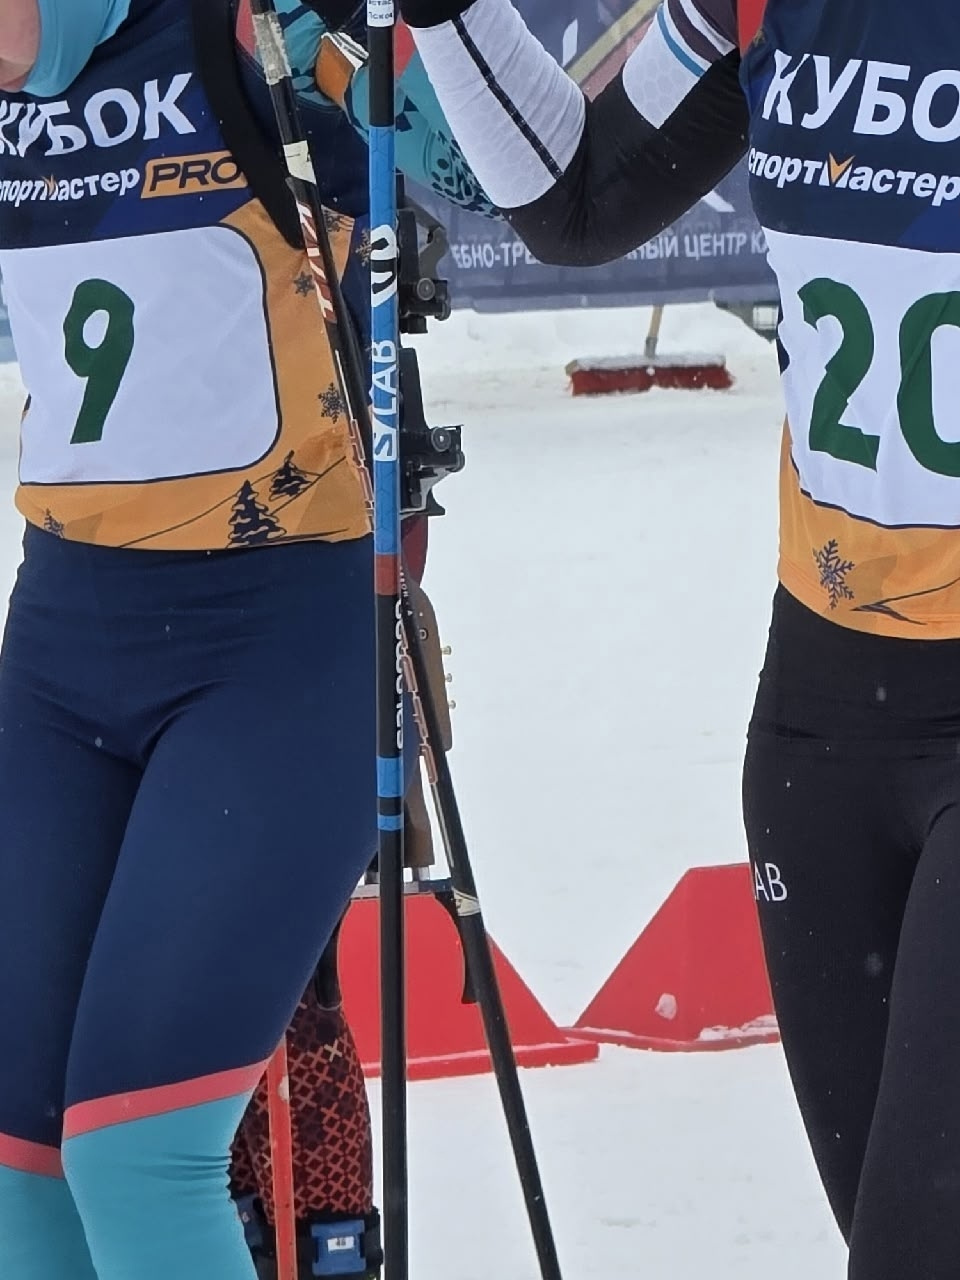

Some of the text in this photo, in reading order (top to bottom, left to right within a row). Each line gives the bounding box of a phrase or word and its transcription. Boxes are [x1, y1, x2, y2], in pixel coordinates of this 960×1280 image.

[0, 72, 197, 158] КУБОК
[149, 156, 242, 192] PRO
[684, 232, 747, 261] ЦЕНТР
[62, 278, 136, 445] 9
